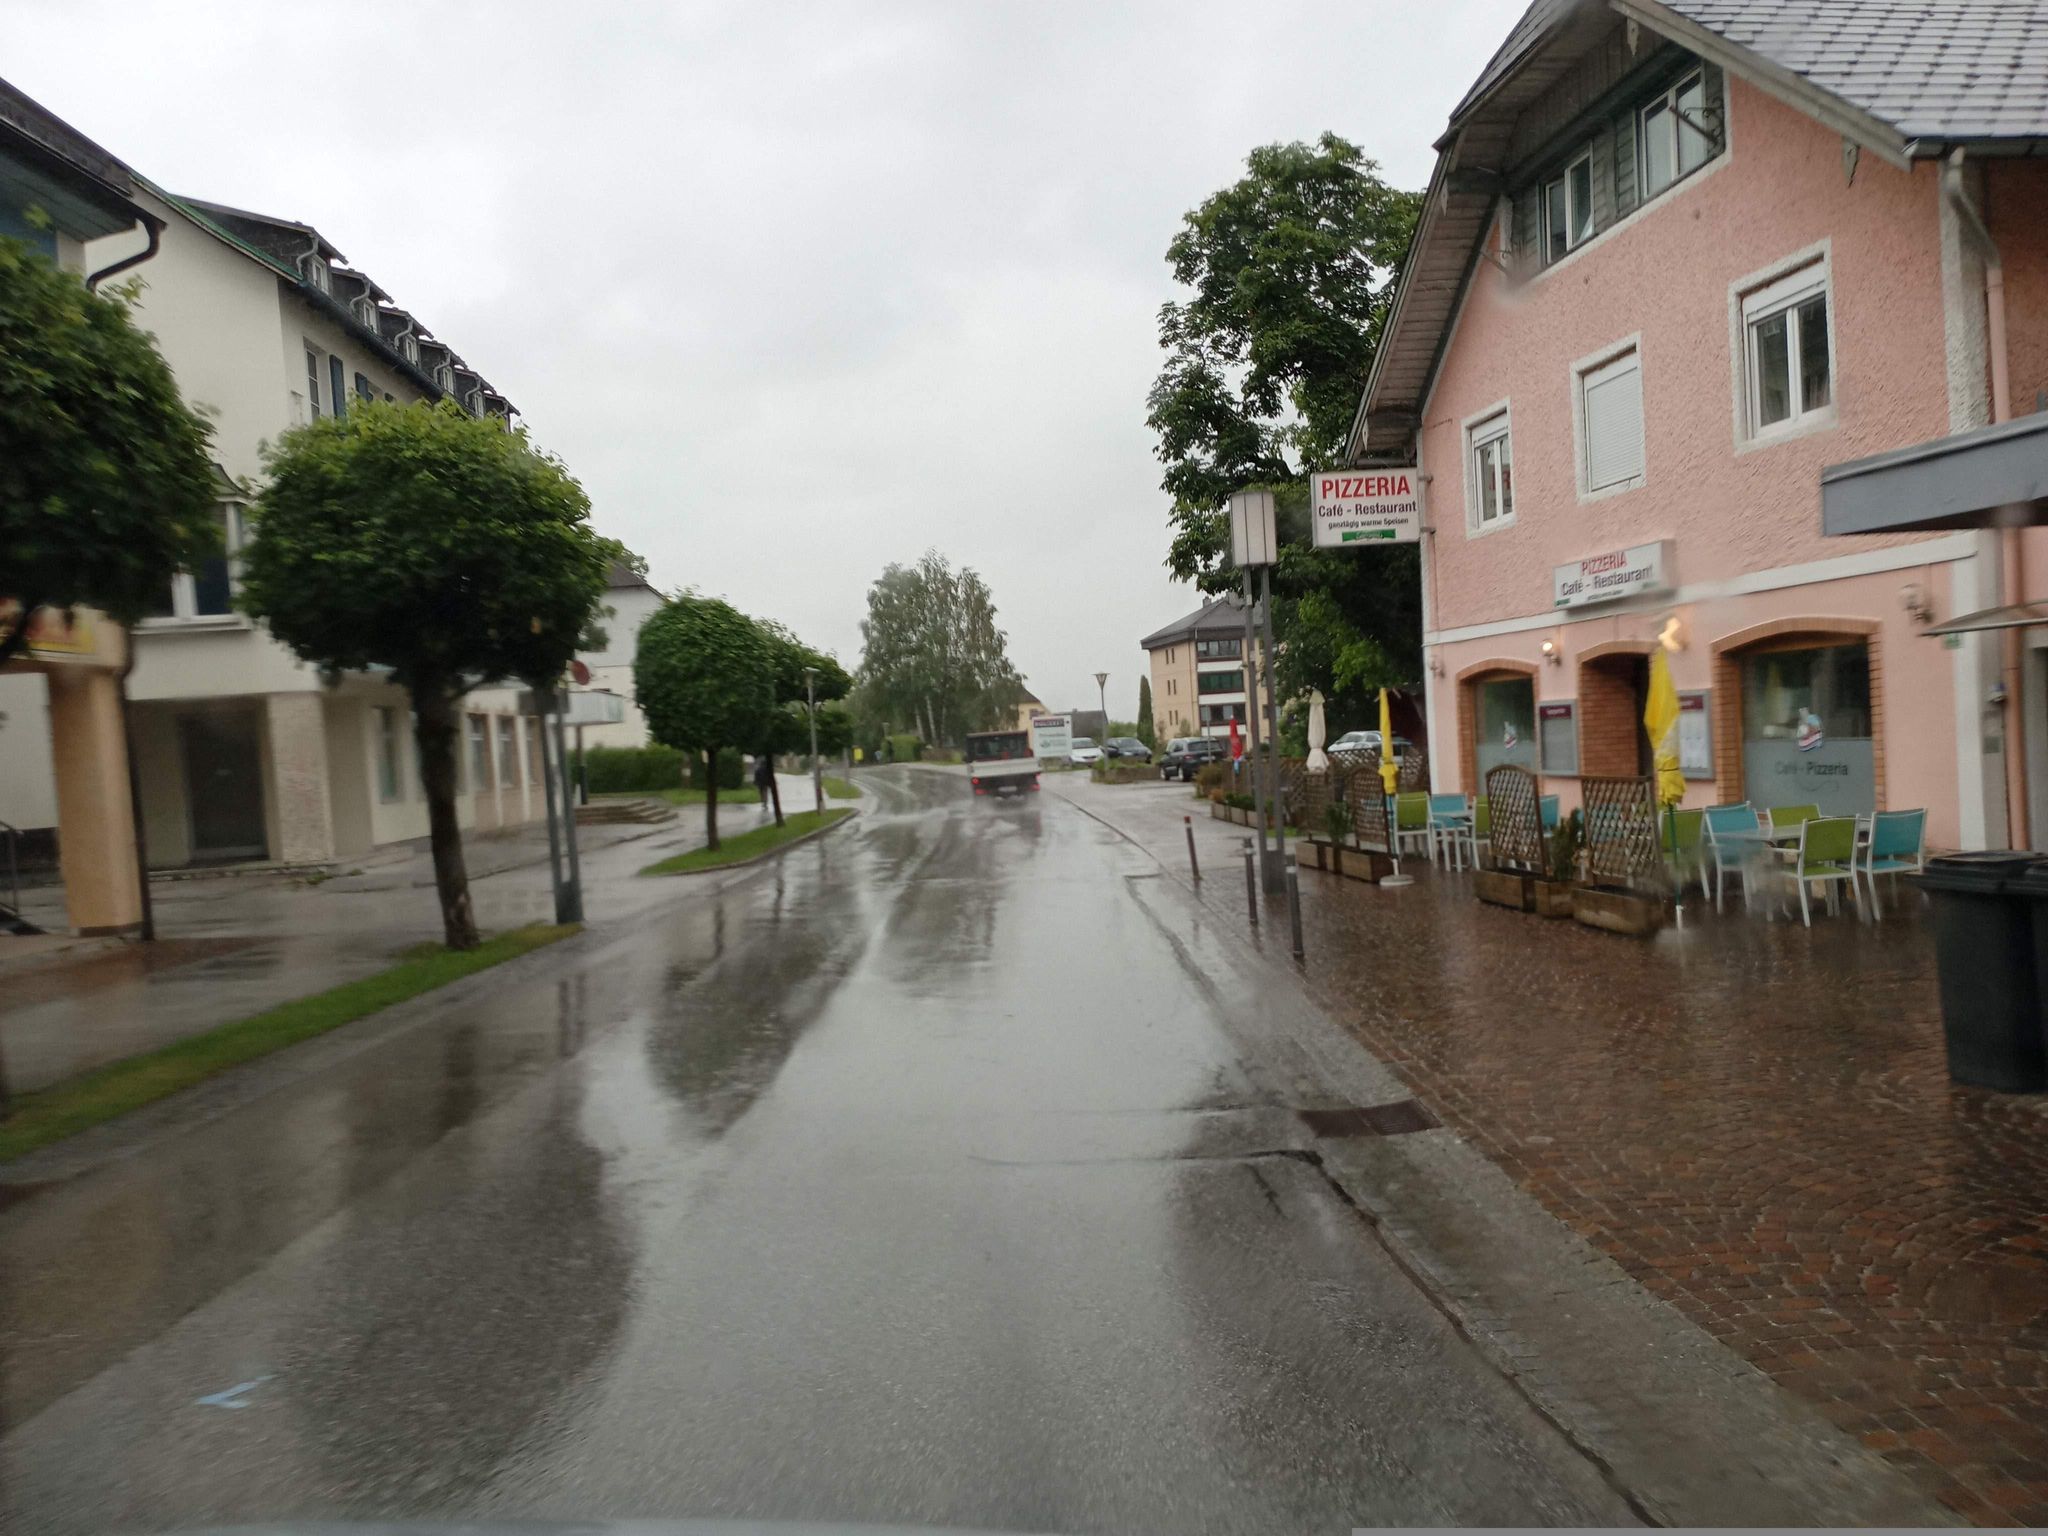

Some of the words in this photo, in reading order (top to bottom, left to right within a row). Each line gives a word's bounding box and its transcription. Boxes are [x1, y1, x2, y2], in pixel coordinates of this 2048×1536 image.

[1322, 475, 1410, 499] PIZZERIA
[1318, 503, 1343, 518] Café
[1355, 500, 1417, 516] Restaurant
[1361, 518, 1382, 527] warme
[1384, 517, 1408, 526] Speisen
[1582, 551, 1627, 575] PIZZERIA
[1561, 579, 1584, 596] Café
[1594, 565, 1653, 589] Restaurant
[1807, 761, 1848, 775] Pizzeria
